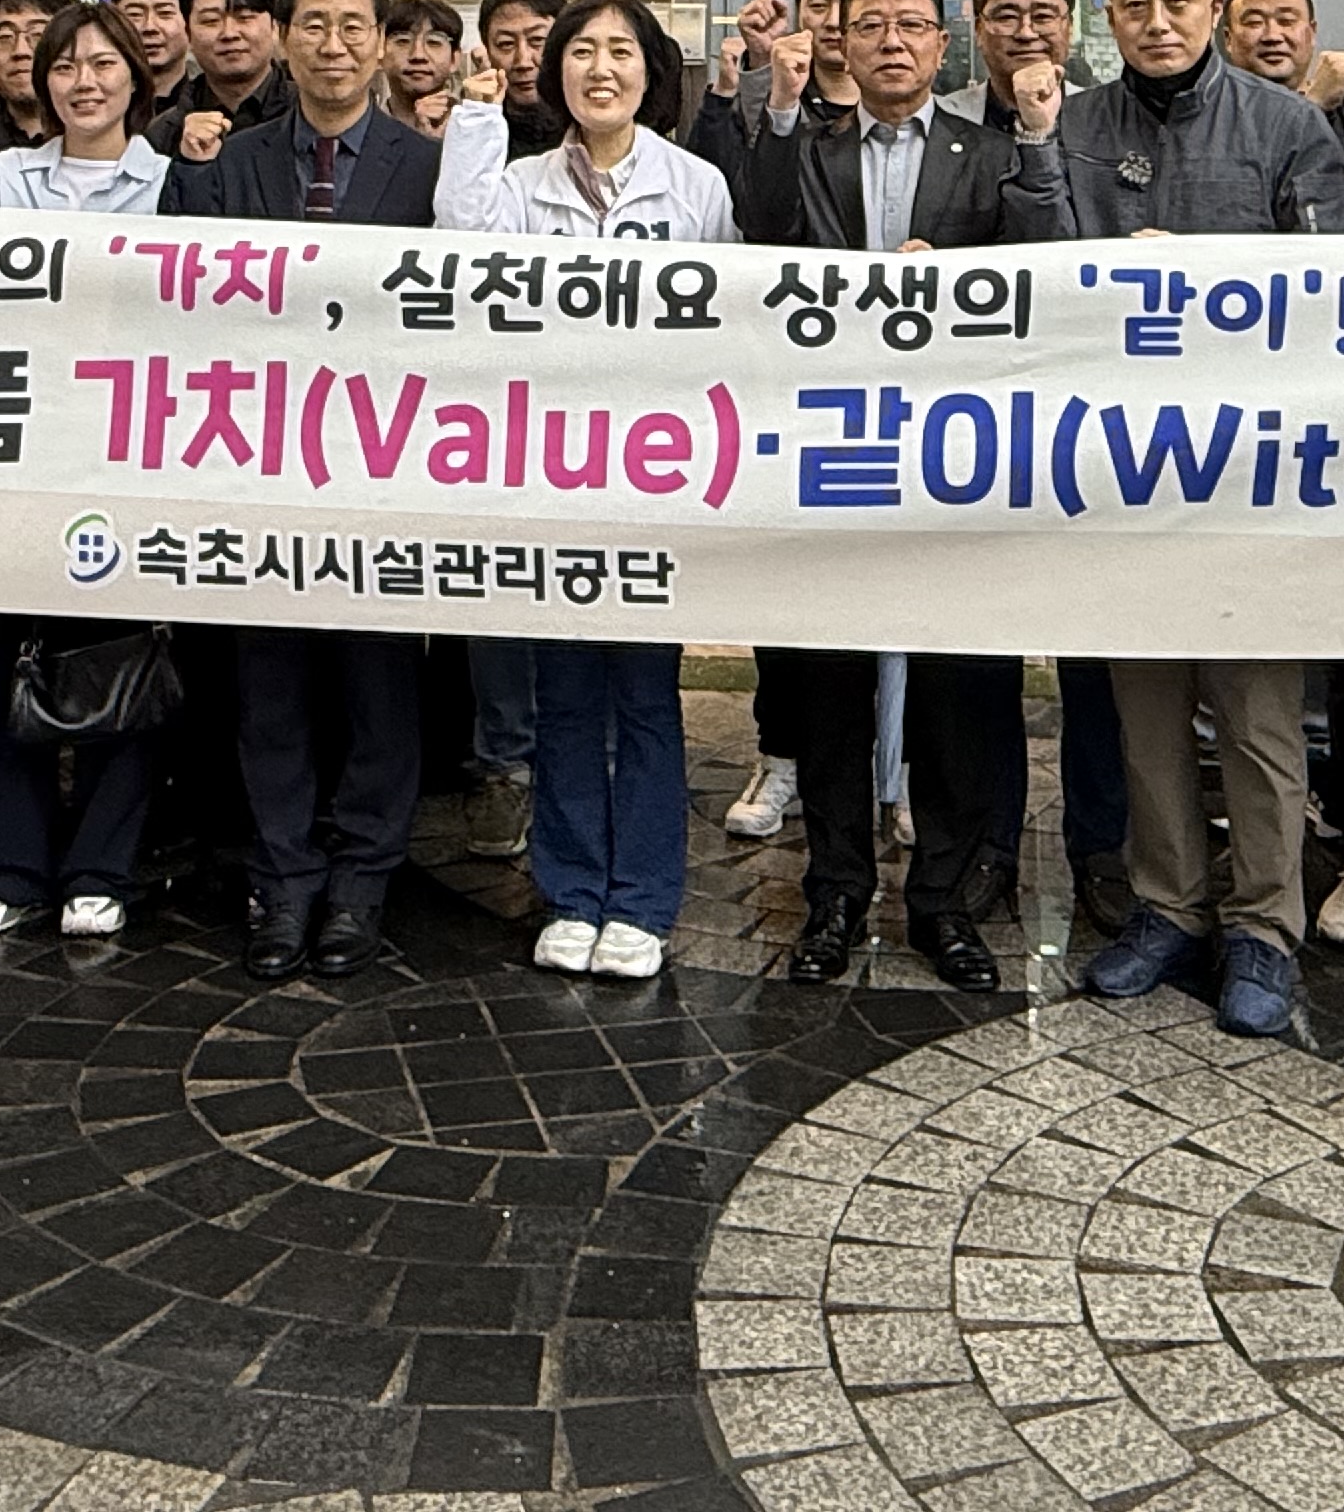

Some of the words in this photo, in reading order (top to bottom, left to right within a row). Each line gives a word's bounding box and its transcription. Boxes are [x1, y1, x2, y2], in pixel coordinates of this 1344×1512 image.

[382, 250, 720, 332] 실천해요
[763, 262, 1032, 351] 상생의
[137, 528, 675, 605] 속초시시설관리공단
